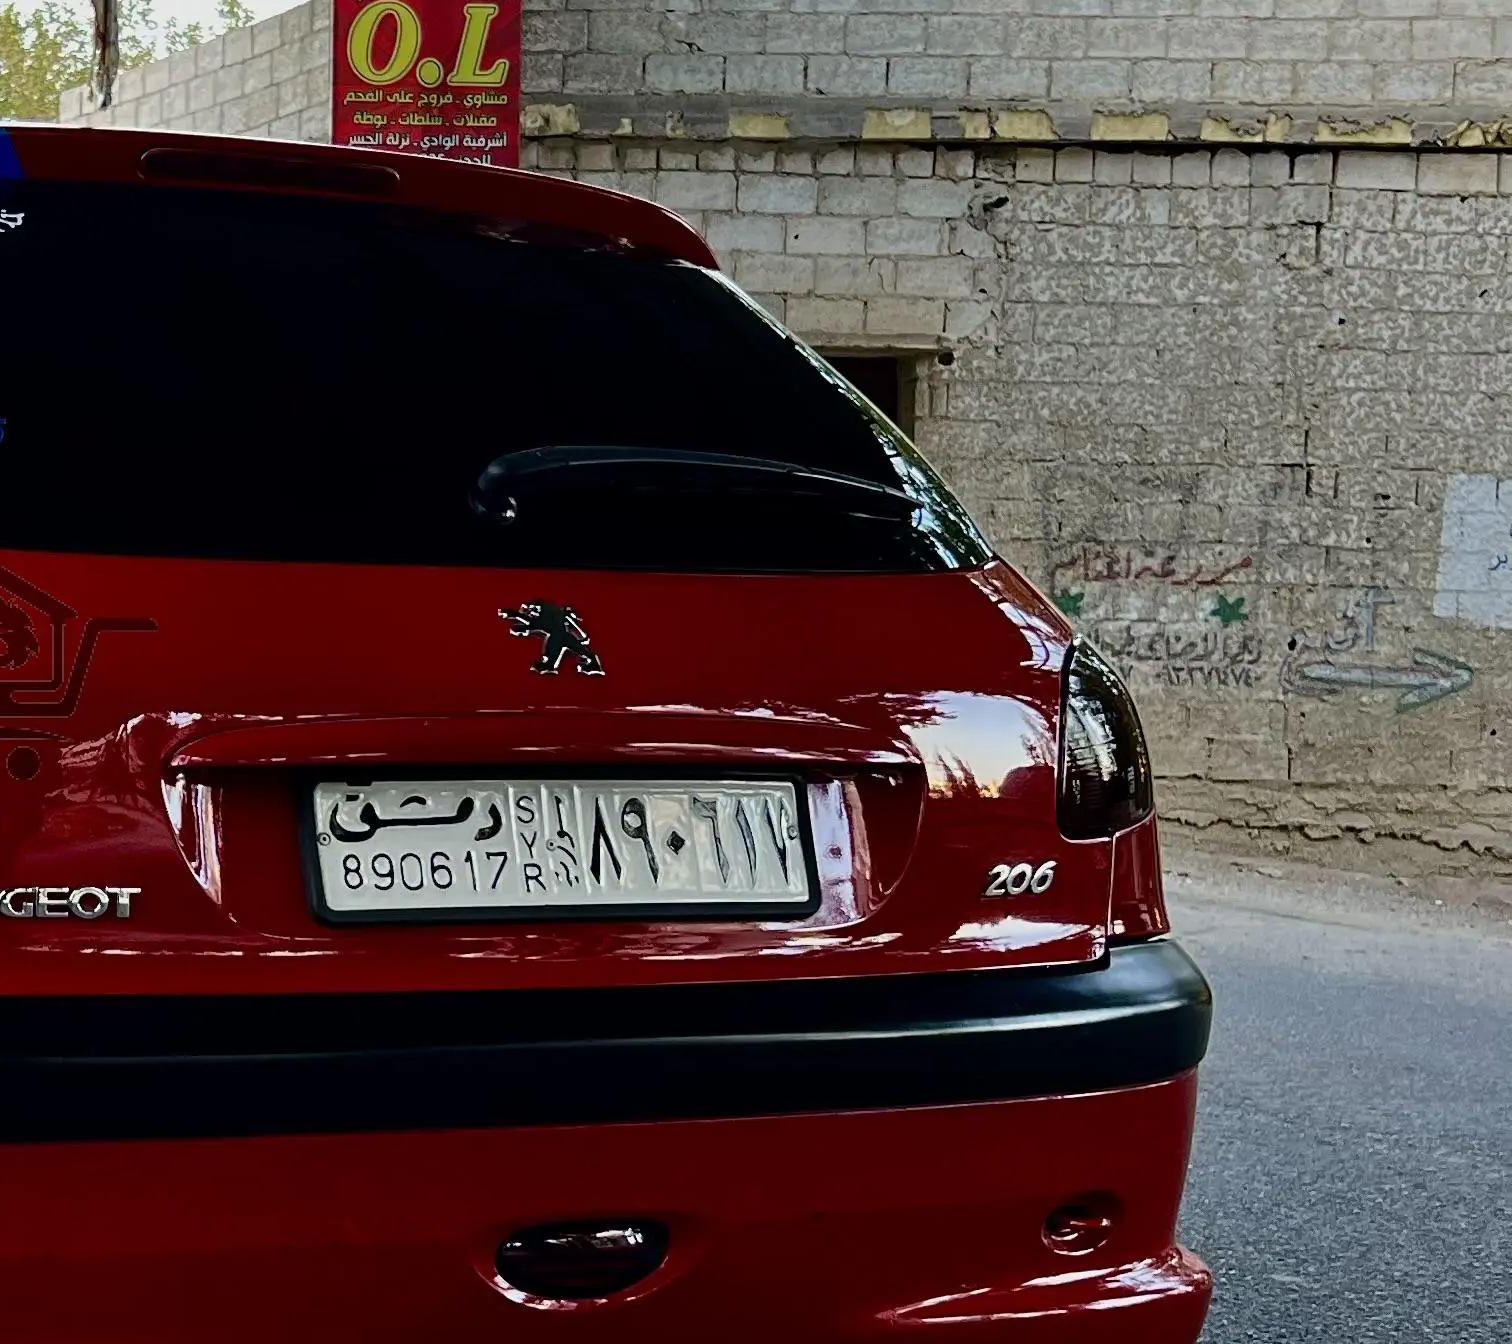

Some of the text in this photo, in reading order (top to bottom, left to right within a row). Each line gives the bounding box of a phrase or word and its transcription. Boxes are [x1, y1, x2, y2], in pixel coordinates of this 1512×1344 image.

[347, 0, 510, 87] O.L
[343, 89, 508, 108] مشاوي فروج على الفحم
[353, 111, 497, 129] مقبلات سلطات بوظة
[385, 131, 410, 150] نزلة
[419, 132, 459, 151] الوادي
[462, 130, 508, 151] أشرفية
[328, 791, 503, 842] دمشق
[589, 794, 791, 889] ٨٩٠٦١٧
[342, 850, 509, 892] 890617
[984, 860, 1058, 896] 206
